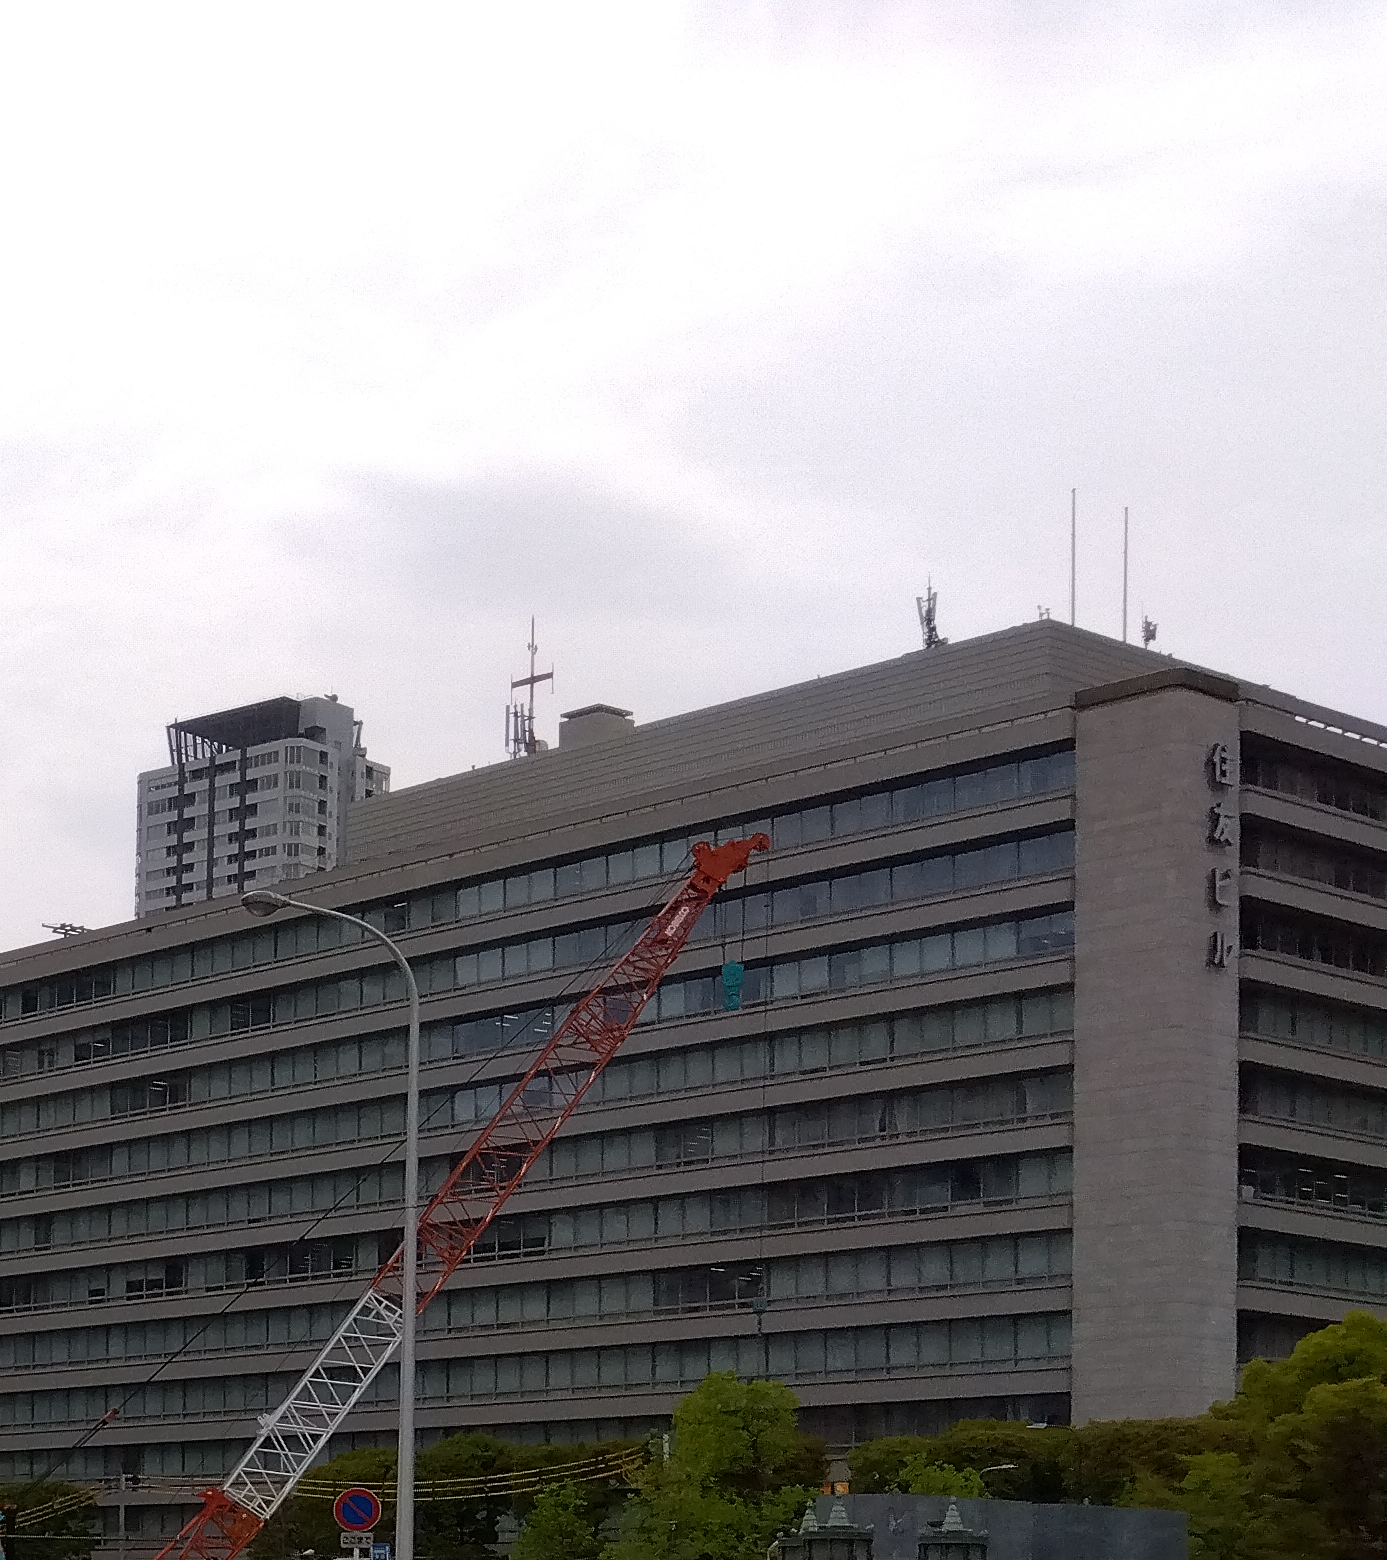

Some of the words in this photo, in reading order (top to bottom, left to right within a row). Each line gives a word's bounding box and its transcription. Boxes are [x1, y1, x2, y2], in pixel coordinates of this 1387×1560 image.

[1208, 743, 1238, 967] 住友ビル
[342, 1536, 371, 1545] ここまで
